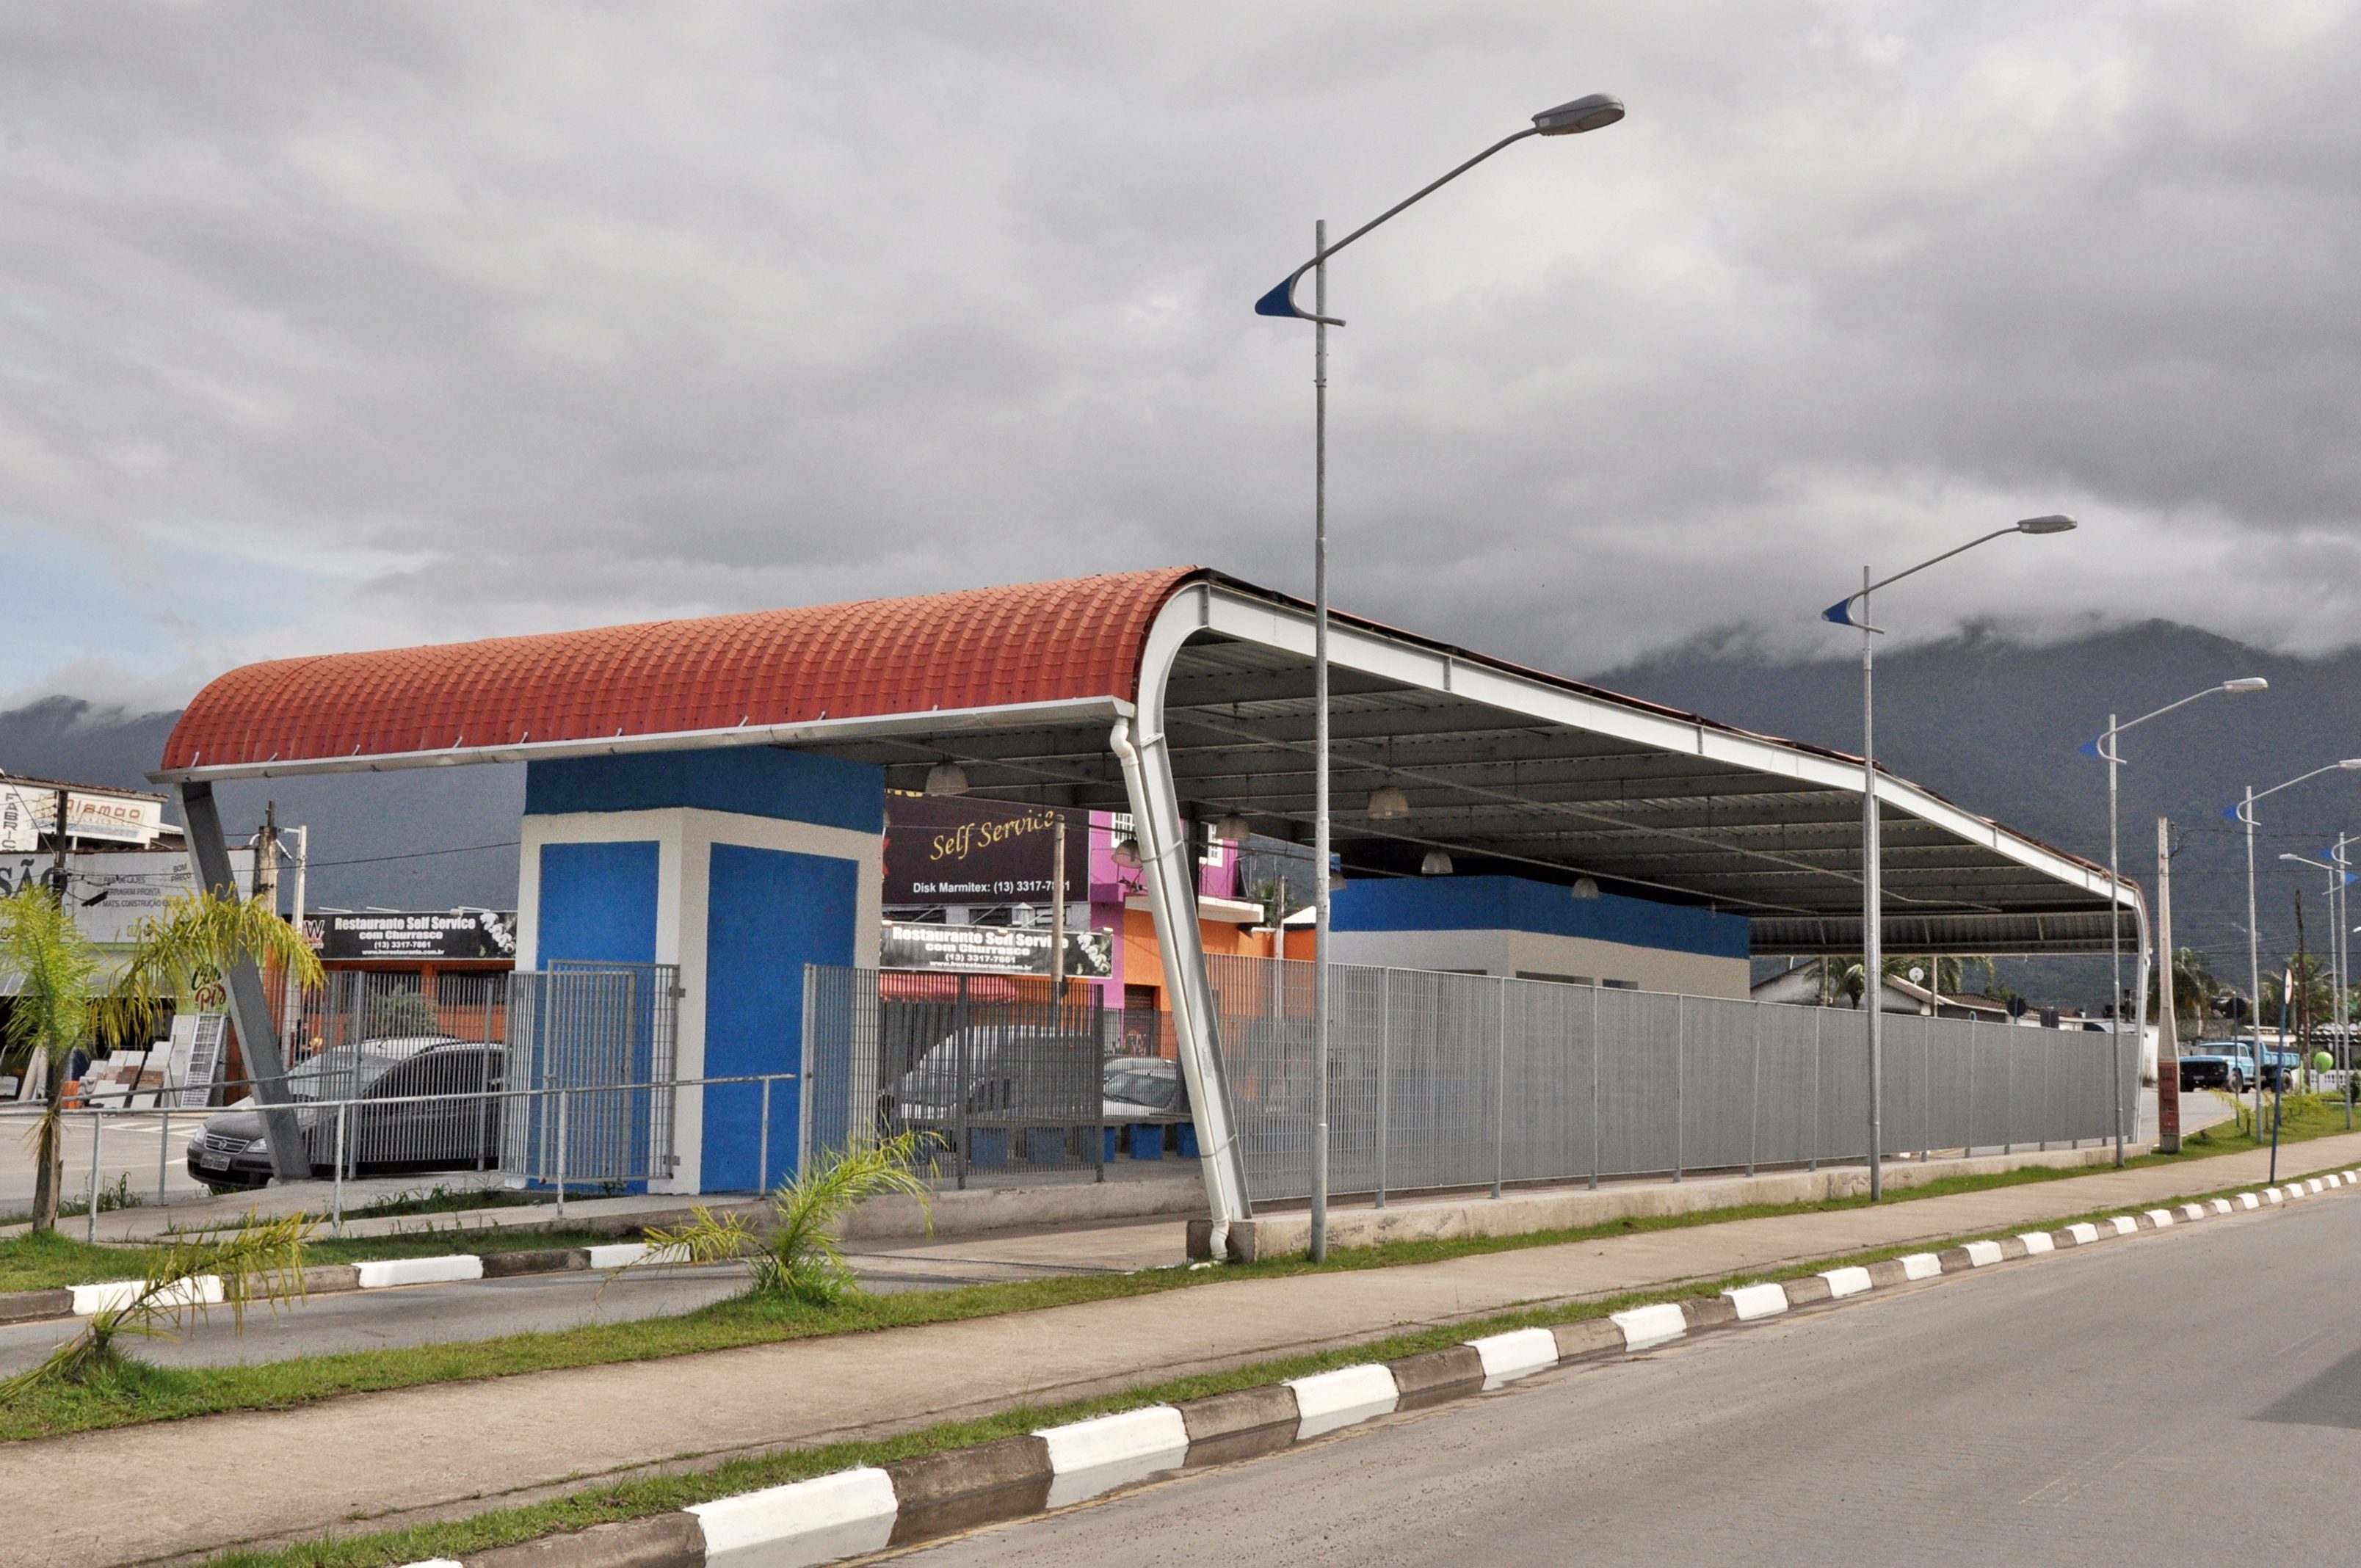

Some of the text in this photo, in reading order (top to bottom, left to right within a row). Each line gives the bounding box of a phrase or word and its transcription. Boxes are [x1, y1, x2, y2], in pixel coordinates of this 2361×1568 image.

[930, 809, 1053, 860] Self Service
[173, 863, 187, 873] BOM
[137, 888, 162, 896] PRONTA
[913, 880, 1070, 894] Disk Marmitex: (13) 3317-71
[335, 916, 476, 930] Restaurante Self Service
[359, 930, 443, 940] com Churrasco
[893, 926, 982, 944] Restaurante
[1016, 933, 1069, 948] Servie
[374, 941, 390, 950] (13)
[925, 943, 1031, 956] com Churrasco
[945, 953, 1016, 964] (13) 3317-7861
[929, 960, 1033, 970] www.hwrestaurante.com.br
